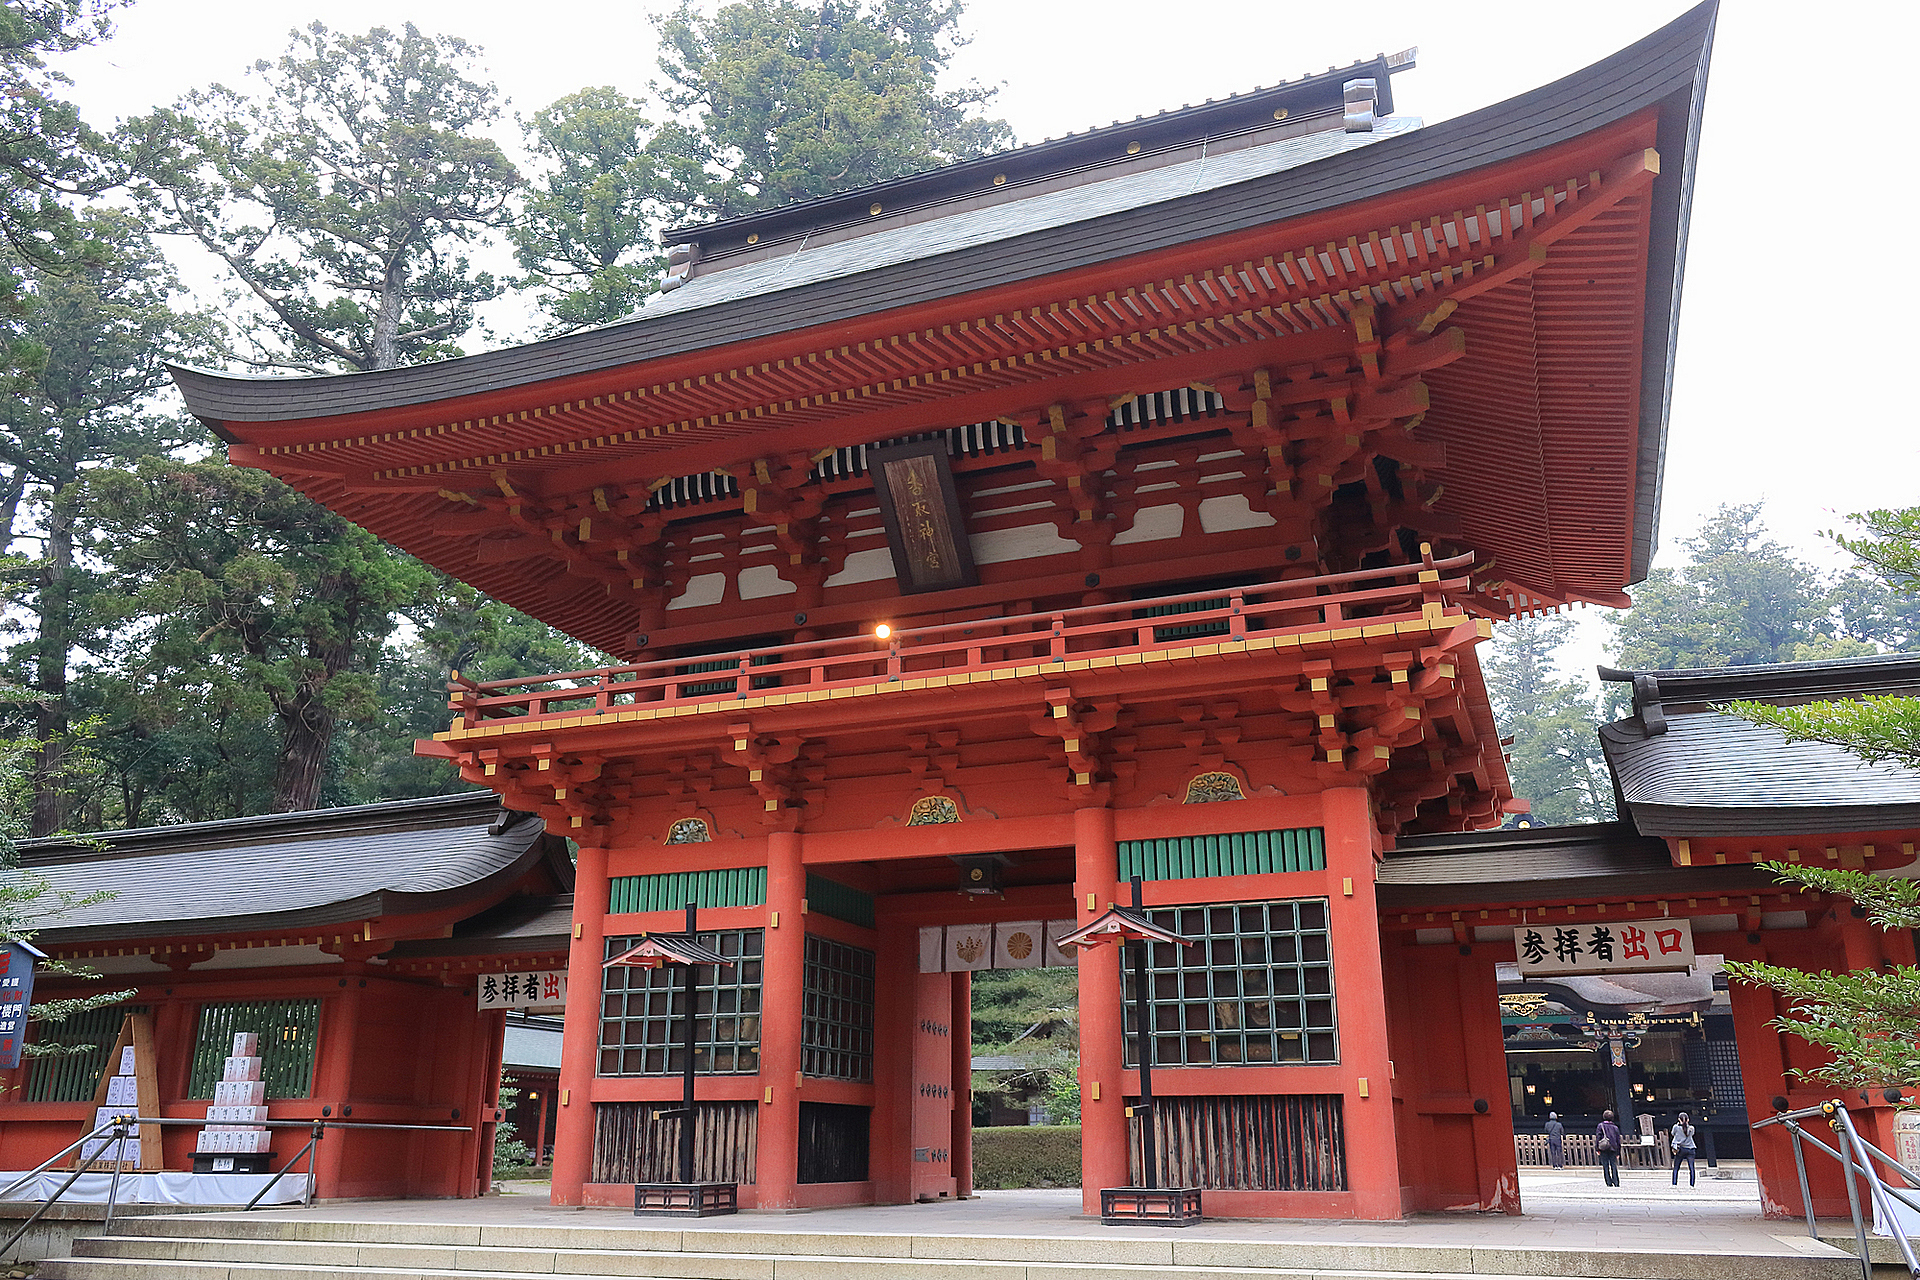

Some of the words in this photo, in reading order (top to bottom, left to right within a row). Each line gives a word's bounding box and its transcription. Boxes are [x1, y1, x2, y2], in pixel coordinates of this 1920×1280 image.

[1521, 925, 1683, 965] 参拝者出口
[0, 978, 20, 987] 愛護
[481, 972, 568, 1003] 参拝者出
[0, 1004, 22, 1018] 楼門
